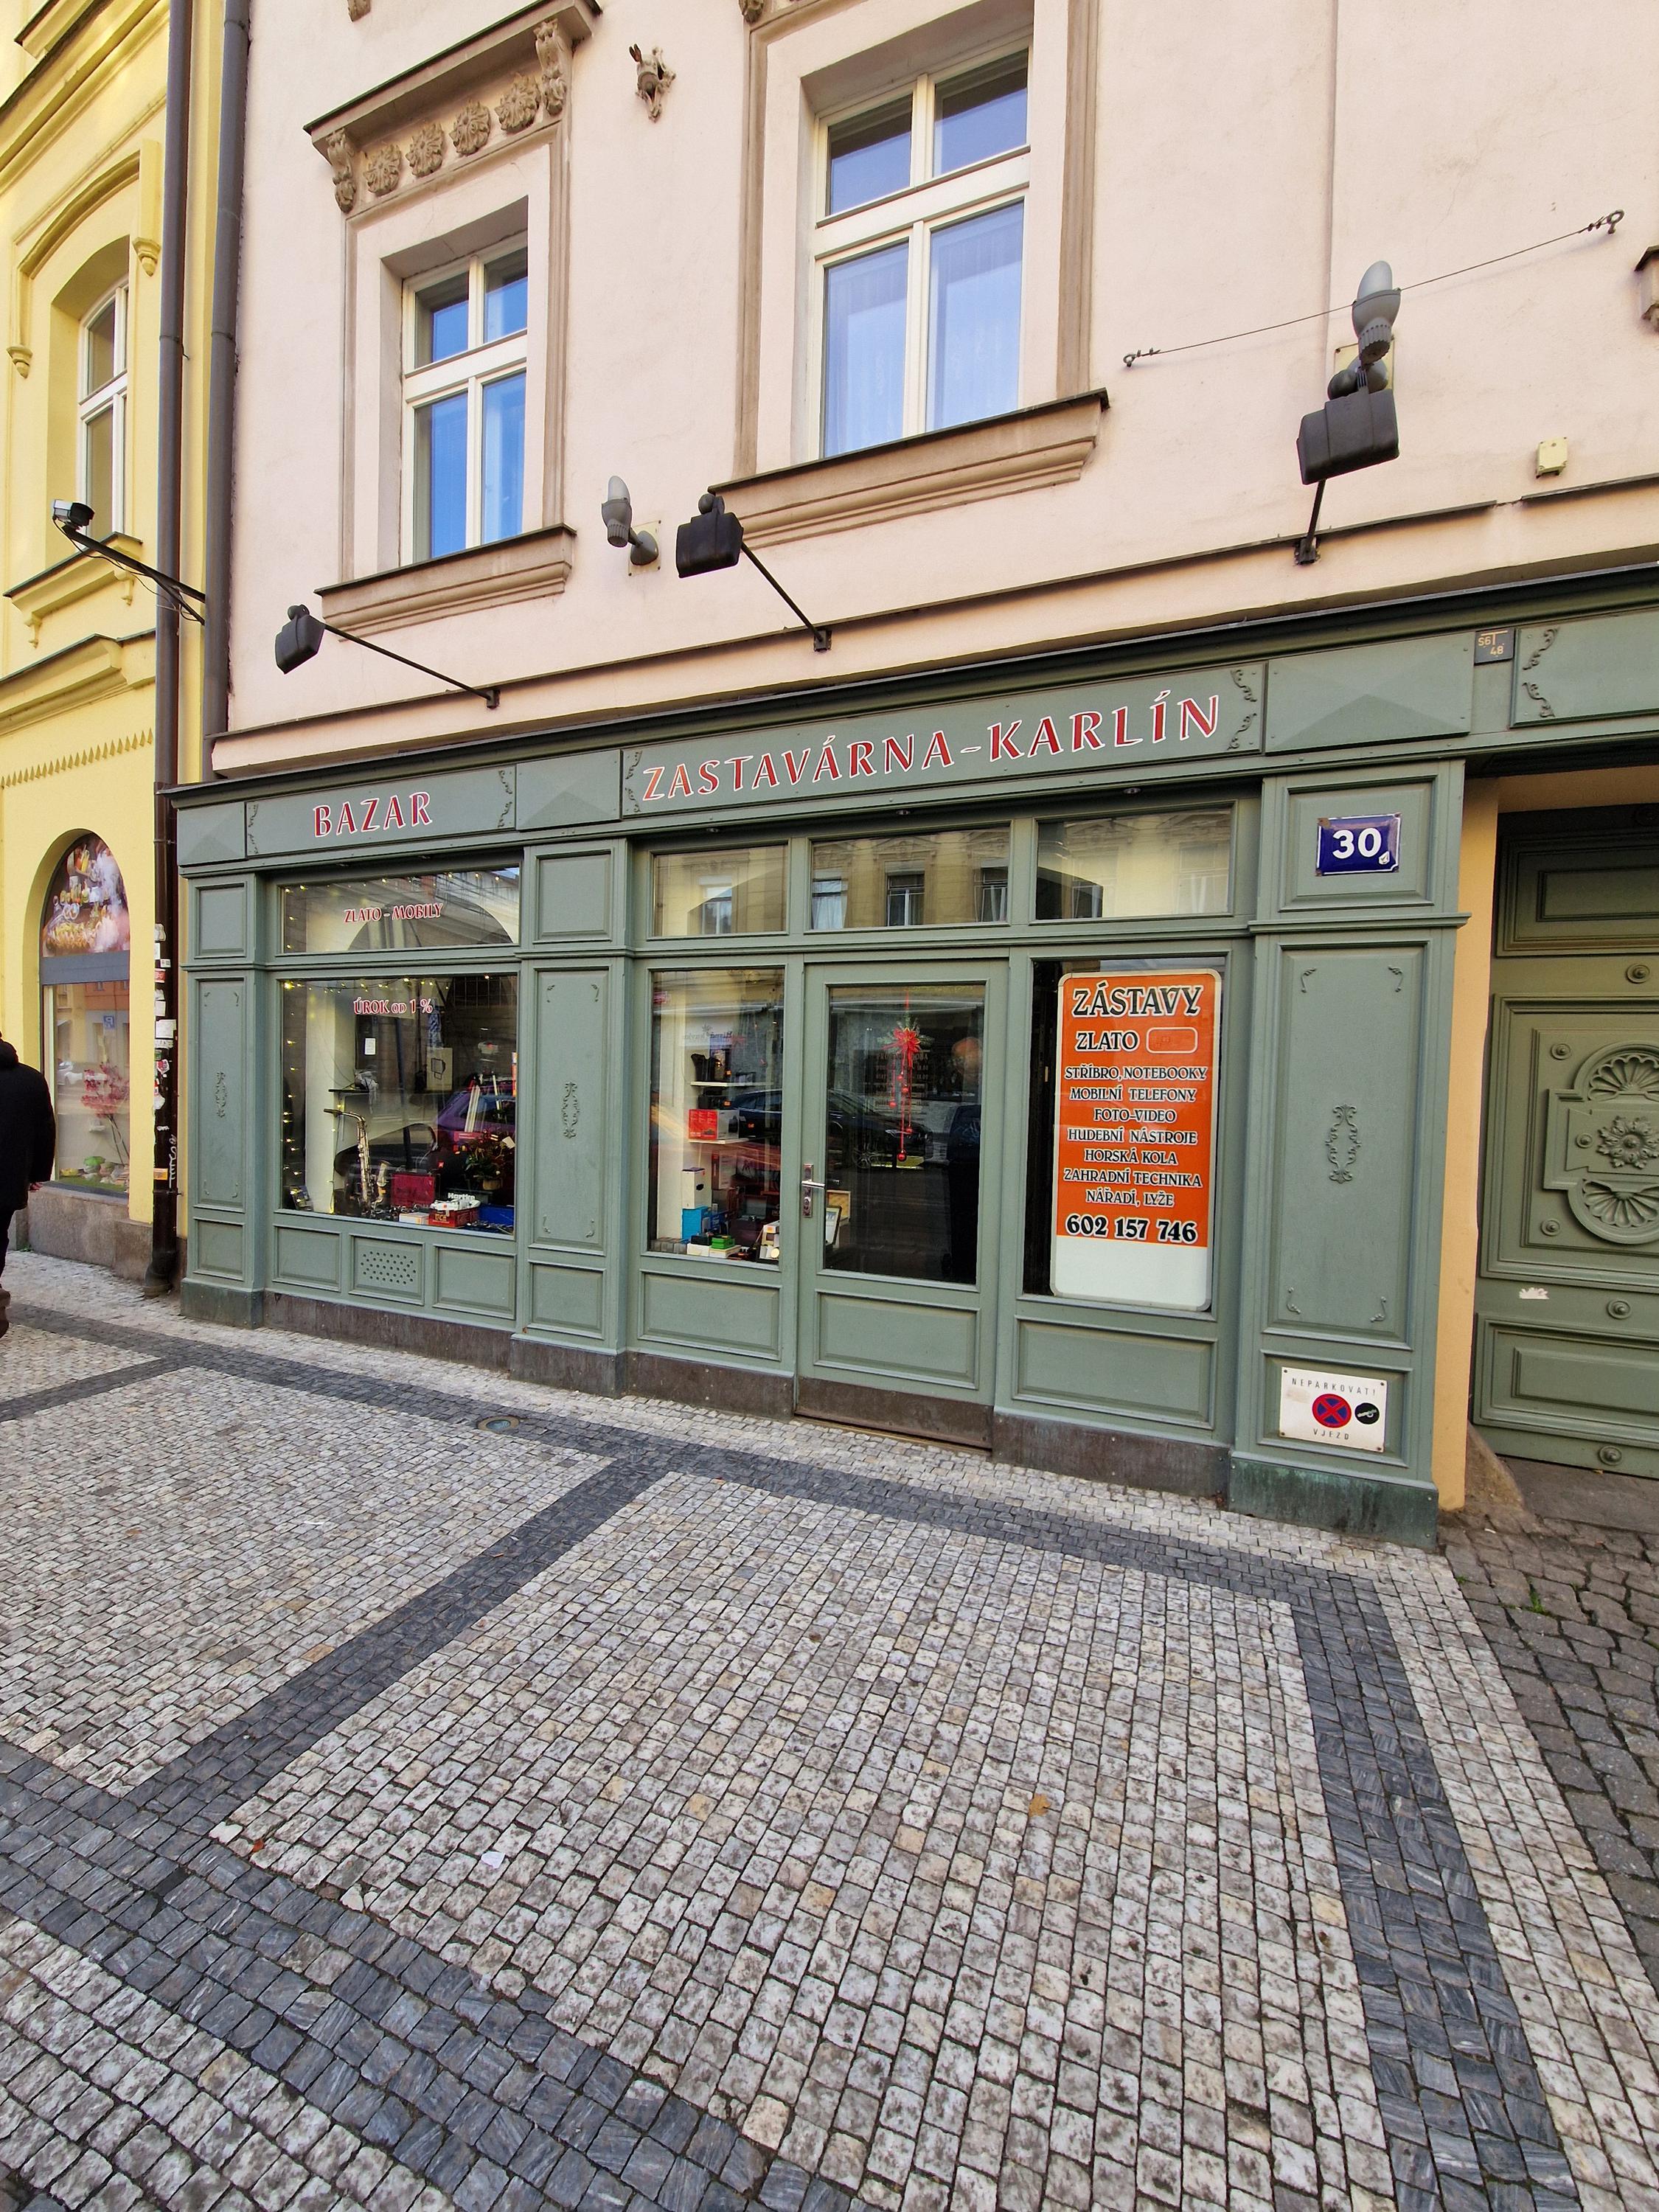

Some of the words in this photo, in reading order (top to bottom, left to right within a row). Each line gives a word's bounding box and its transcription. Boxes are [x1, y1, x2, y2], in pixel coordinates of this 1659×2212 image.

[313, 791, 433, 838] BAZAR
[1332, 827, 1382, 859] 30
[344, 908, 382, 923] ZLATO
[392, 903, 443, 920] MOBILY
[353, 997, 390, 1015] ÚROK
[410, 999, 416, 1014] 1
[1071, 981, 1203, 1016] ZÁSTAVY
[1077, 1031, 1138, 1051] ZLATO
[1065, 1065, 1122, 1081] STŘÍBRO,
[1124, 1067, 1207, 1080] NOTEBOOKY
[1070, 1085, 1123, 1101] MOBILNÍ
[1130, 1088, 1196, 1102] TELEFONY
[1095, 1108, 1176, 1123] FOTO-VIDEO
[1068, 1127, 1124, 1142] HUDEBNÍ
[1130, 1128, 1197, 1144] NÁSTROJE
[1085, 1148, 1138, 1164] HORSKÁ
[1142, 1151, 1178, 1164] KOLA
[1064, 1168, 1130, 1183] ZAHRADNÍ
[1133, 1172, 1203, 1187] TECHNIKA
[1086, 1187, 1140, 1206] NÁŘADÍ,
[1144, 1191, 1175, 1206] LYŽE
[1066, 1214, 1108, 1237] 602
[1115, 1217, 1150, 1239] 157
[1157, 1220, 1197, 1243] 746
[1292, 1377, 1376, 1396] NEPARKOVAT!
[1313, 1428, 1349, 1440] VJEZD
